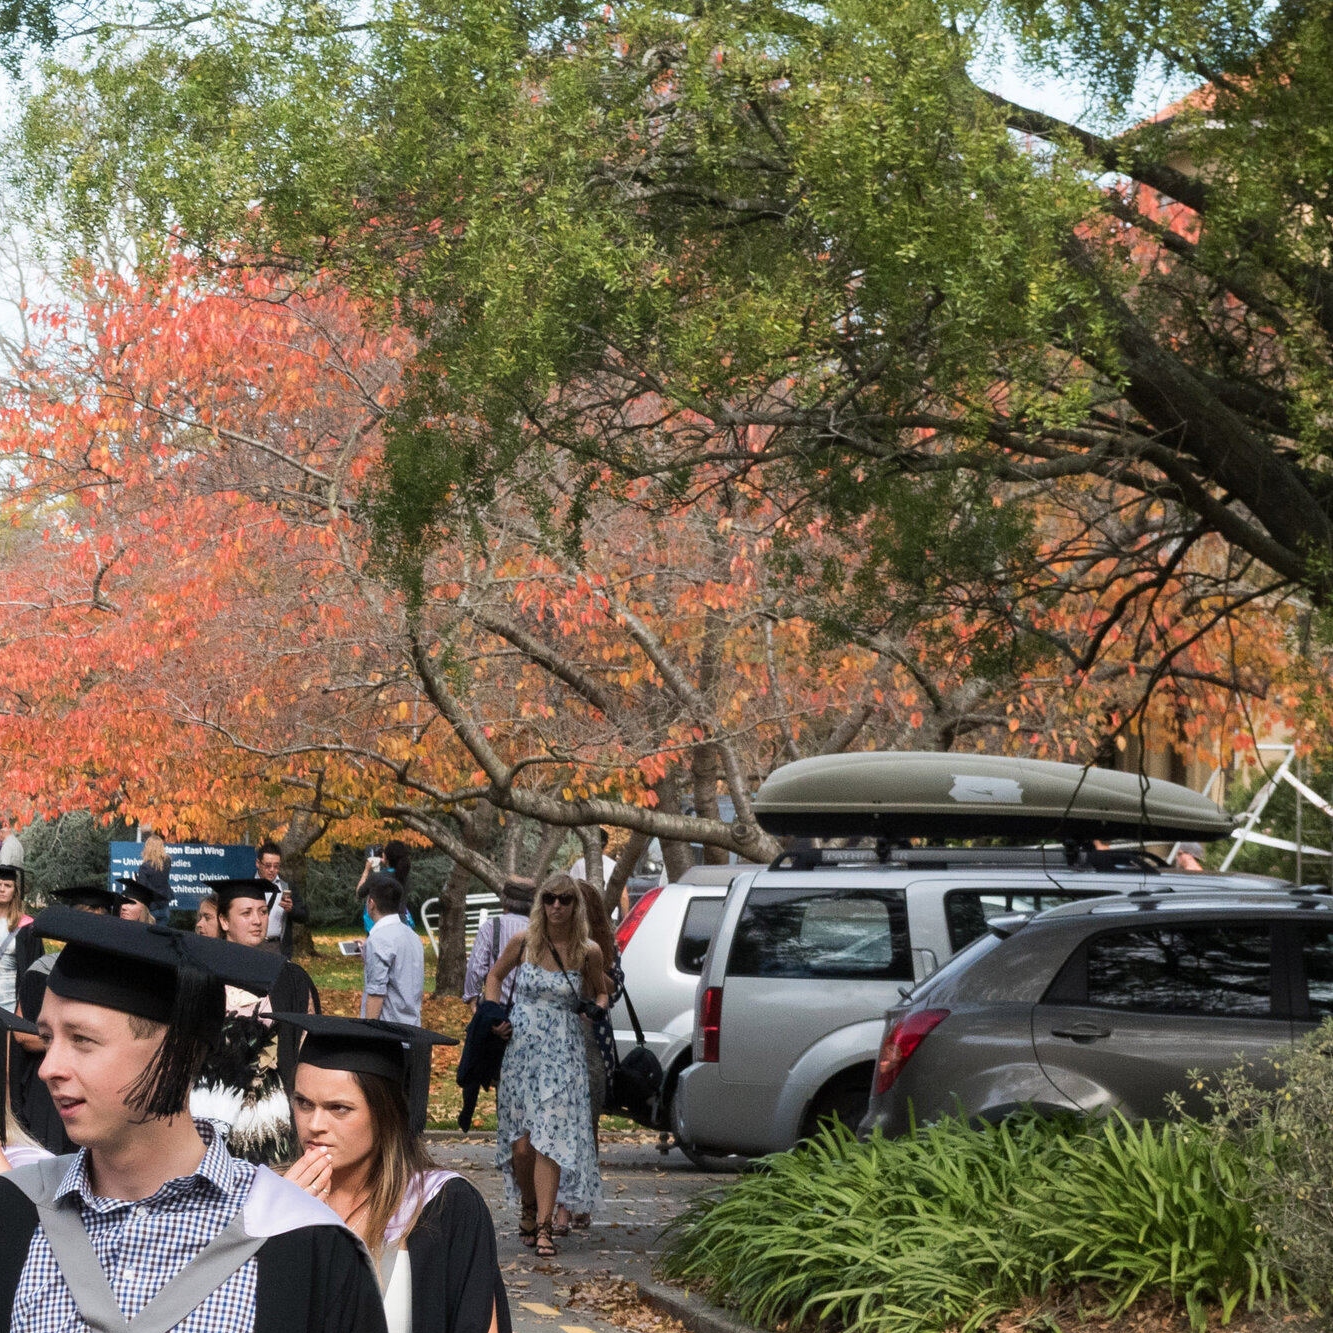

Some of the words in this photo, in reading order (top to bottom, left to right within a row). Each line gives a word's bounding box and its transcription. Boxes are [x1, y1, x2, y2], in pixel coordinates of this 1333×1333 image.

[184, 846, 203, 855] East
[204, 846, 225, 857] Wing
[169, 873, 197, 882] nguage
